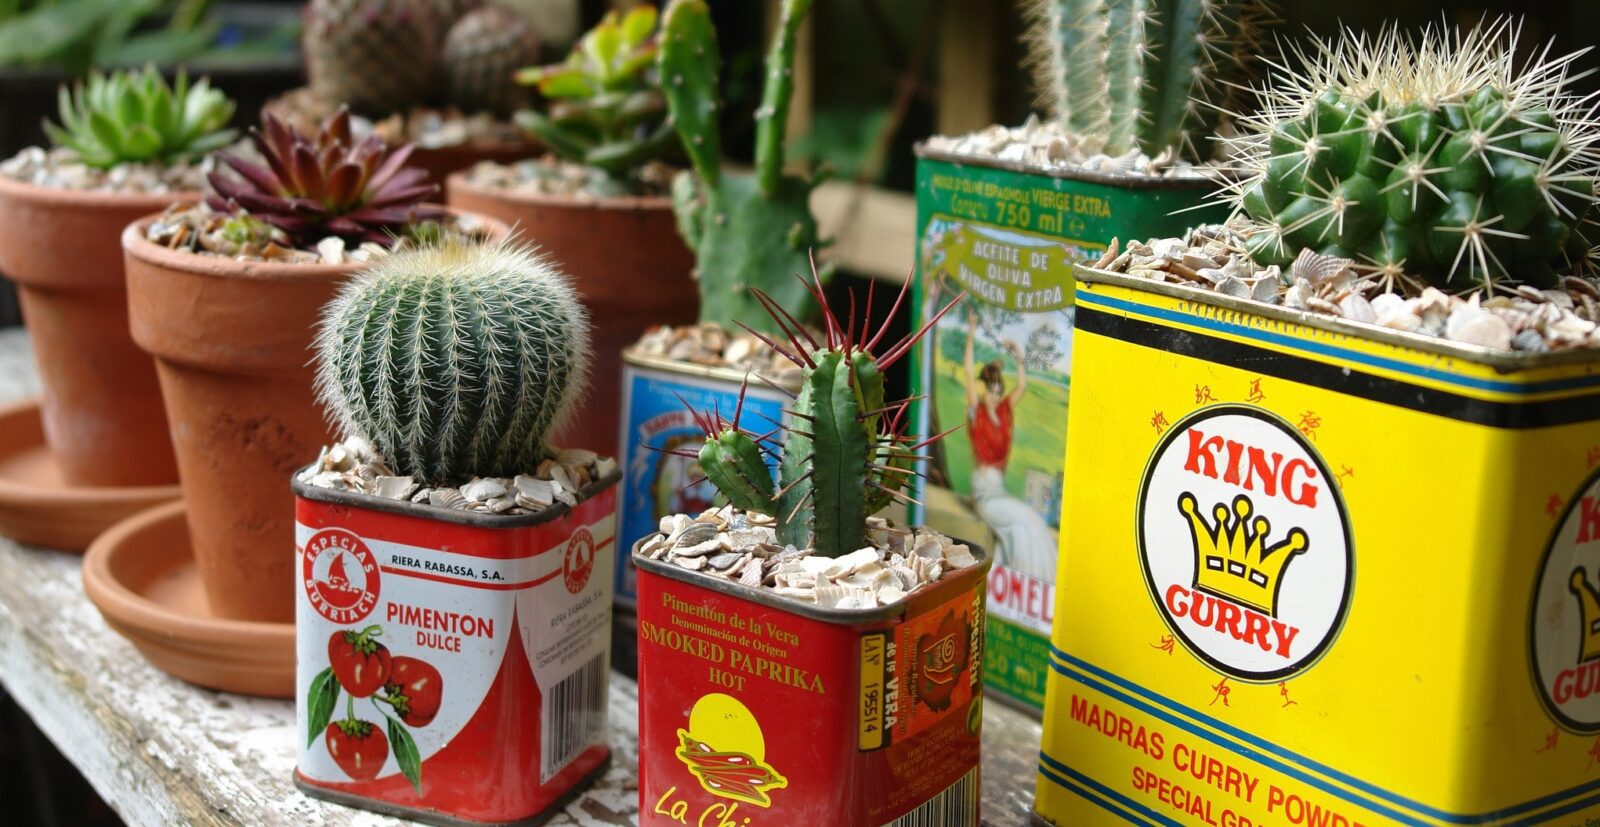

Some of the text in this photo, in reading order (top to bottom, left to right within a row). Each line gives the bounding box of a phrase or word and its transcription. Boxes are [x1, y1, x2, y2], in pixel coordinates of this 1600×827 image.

[995, 201, 1031, 227] 750
[1038, 212, 1063, 232] ml
[1032, 188, 1070, 212] VIERGE
[1073, 194, 1112, 218] EXTRA
[973, 240, 1049, 271] ACEITE DE
[987, 263, 1031, 288] OLIVA
[959, 264, 1063, 309] VIRGEN EXTRA
[1184, 427, 1319, 509] KING
[306, 535, 375, 574] ESPECIAS
[391, 554, 505, 581] RIERA RABASSA, S.A.
[306, 578, 376, 622] BURRIACH
[987, 565, 1053, 625] ONEL
[386, 602, 494, 639] PIMENTON
[661, 591, 801, 647] Pimentón de la Vera
[671, 613, 788, 659] Denominación de Origen
[416, 630, 461, 653] DULCE
[641, 620, 726, 664] SMOKED
[728, 648, 827, 695] PAPRIKA
[707, 666, 747, 692] HOT
[884, 641, 900, 730] de la VERA
[863, 682, 880, 734] 195514
[1070, 693, 1369, 827] MADRAS CURRY POWD
[655, 785, 688, 825] La
[1132, 766, 1218, 827] SPECIAL
